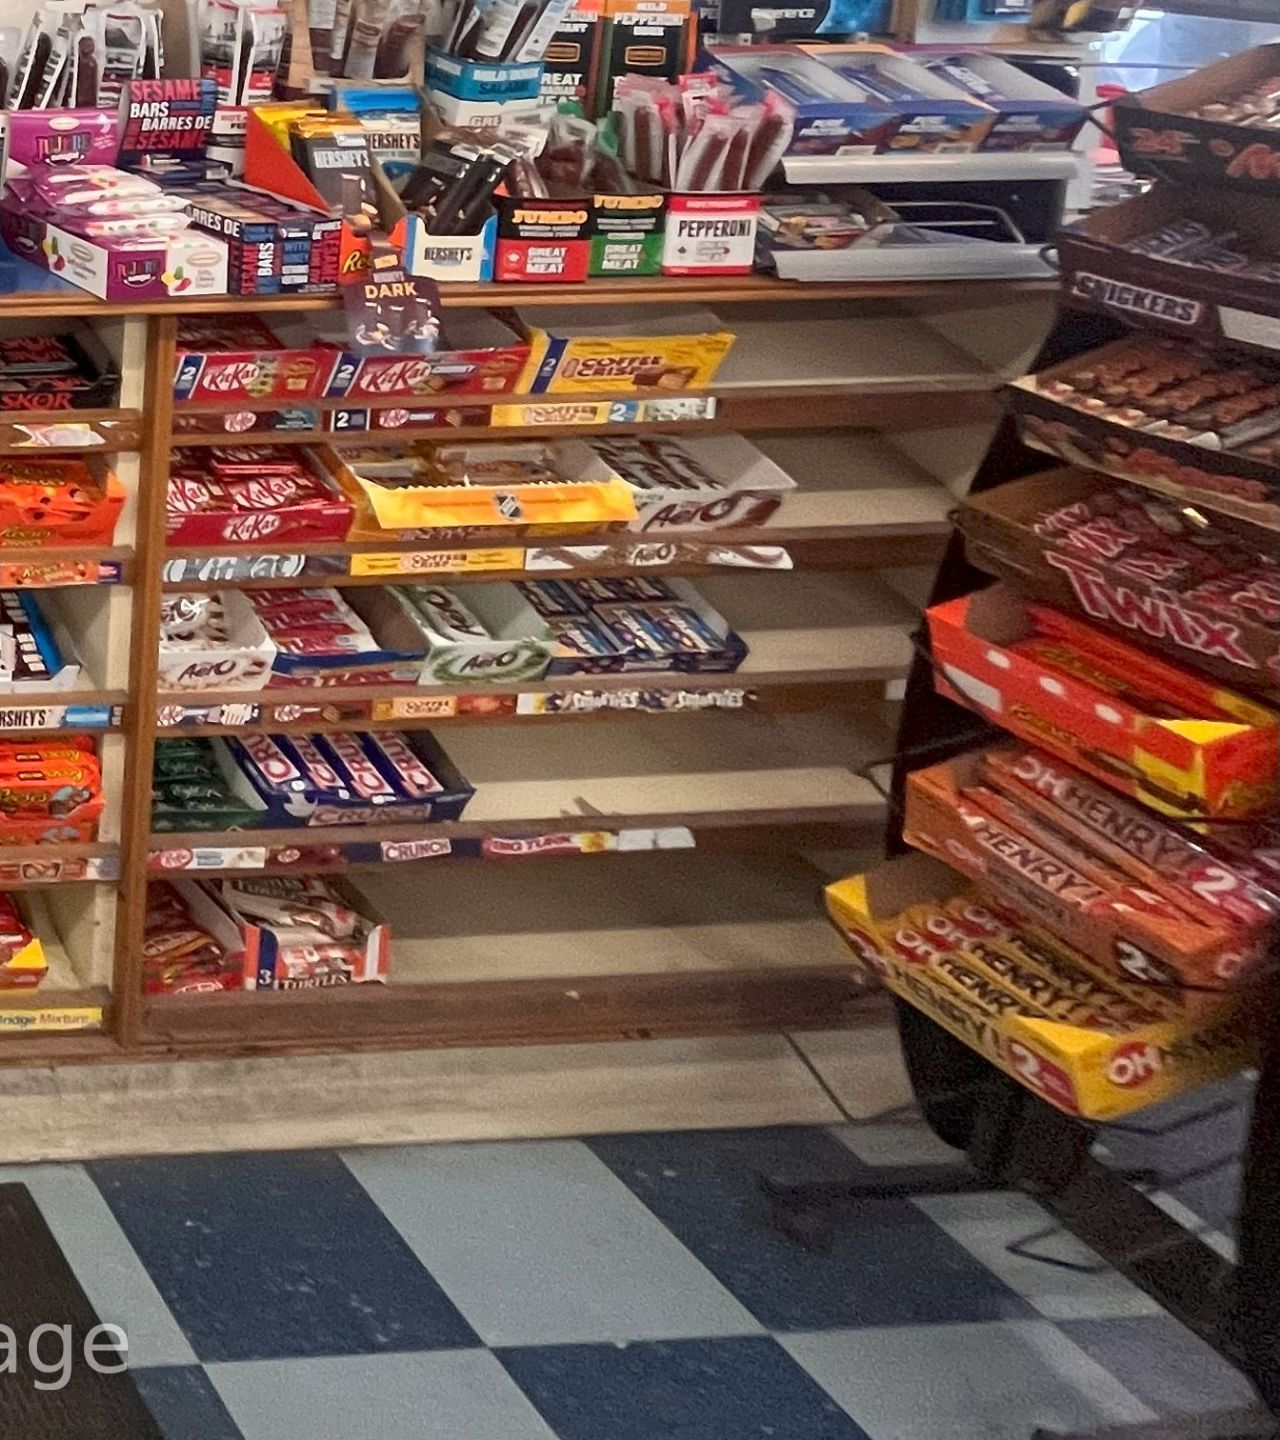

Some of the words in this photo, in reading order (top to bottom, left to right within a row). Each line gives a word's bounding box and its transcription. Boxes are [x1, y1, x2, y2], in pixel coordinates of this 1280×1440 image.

[130, 79, 202, 102] SESAME
[130, 101, 169, 119] BARS
[141, 116, 193, 132] BARRES
[195, 115, 213, 130] DE
[366, 132, 421, 150] HERSHEY'S
[678, 218, 751, 237] PEPPERONI
[257, 241, 274, 276] BARS
[424, 247, 473, 261] HERSHEY'S
[526, 246, 568, 258] GREAT
[604, 244, 643, 257] GREAT
[526, 260, 565, 274] MEAT
[601, 258, 640, 271] MEAT
[365, 281, 417, 299] DARK
[1074, 271, 1201, 324] SNICKERS
[542, 357, 555, 373] 2
[583, 354, 664, 368] COFFEE
[576, 366, 641, 379] CRISP
[180, 368, 195, 386] 2
[201, 361, 260, 391] KitKat
[338, 364, 353, 382] 2
[359, 358, 436, 392] KitKat
[1, 392, 72, 410] SKOR
[337, 410, 349, 428] 2
[223, 512, 282, 542] KitKat
[1044, 549, 1257, 669] TWIX
[384, 838, 450, 859] CRUNCH
[1190, 866, 1238, 898] 2
[258, 969, 272, 985] 3
[39, 1012, 90, 1026] Mixture
[1107, 1042, 1162, 1087] OH
